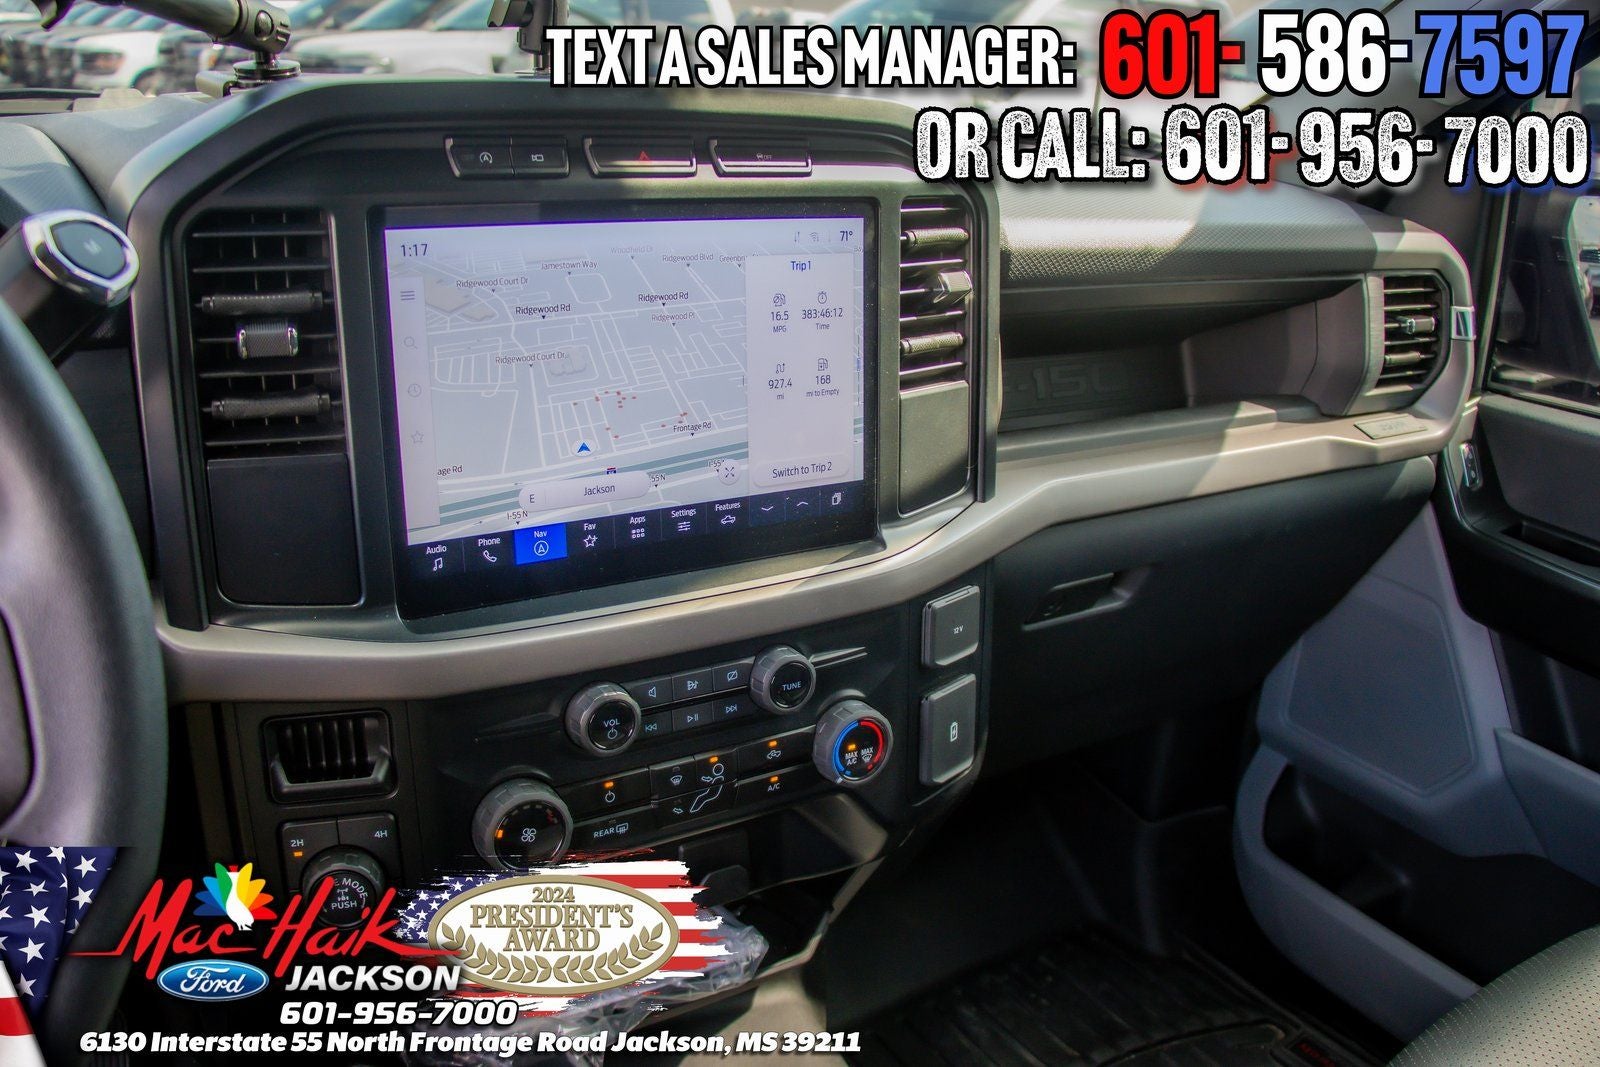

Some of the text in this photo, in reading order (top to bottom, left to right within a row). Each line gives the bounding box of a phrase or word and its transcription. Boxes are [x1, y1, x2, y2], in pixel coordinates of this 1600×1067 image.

[400, 243, 428, 257] 1:17
[662, 253, 714, 263] Ridgewood Blvd
[541, 259, 598, 271] Jamestown Way
[791, 261, 807, 272] Trip
[456, 276, 529, 289] Ridgewood Court Dr
[638, 291, 689, 303] Ridgewood Rd
[515, 303, 571, 316] Ridgewood Rd
[801, 307, 843, 320] 383:46:12
[651, 312, 688, 323] Ridgewood
[771, 310, 789, 322] 16.5
[772, 324, 787, 334] MPG
[815, 322, 830, 331] Time
[495, 354, 536, 365] Ridgewood
[536, 352, 557, 362] Court
[768, 378, 793, 390] 927.4
[815, 374, 831, 385] 168
[806, 387, 840, 397] mi to Empty
[673, 421, 712, 433] Frontage Rd
[437, 464, 463, 477] age Rd
[772, 461, 833, 479] Switch to Trip 2
[529, 484, 616, 504] E Jackson
[715, 500, 741, 512] Features
[522, 509, 528, 518] N
[671, 508, 697, 519] Settings
[629, 515, 646, 525] Apps
[583, 522, 596, 531] Fav
[533, 529, 547, 538] Nav
[477, 536, 501, 547] Phone
[426, 545, 447, 555] Audio
[781, 680, 802, 692] TUNE
[603, 718, 621, 729] VOL
[845, 751, 859, 760] MAX
[861, 747, 874, 756] MAX
[767, 782, 781, 793] A/C
[374, 829, 388, 839] 4H
[593, 827, 615, 839] REAR
[290, 838, 304, 848] 2H
[341, 877, 368, 899] MODE
[331, 900, 358, 910] PUSH
